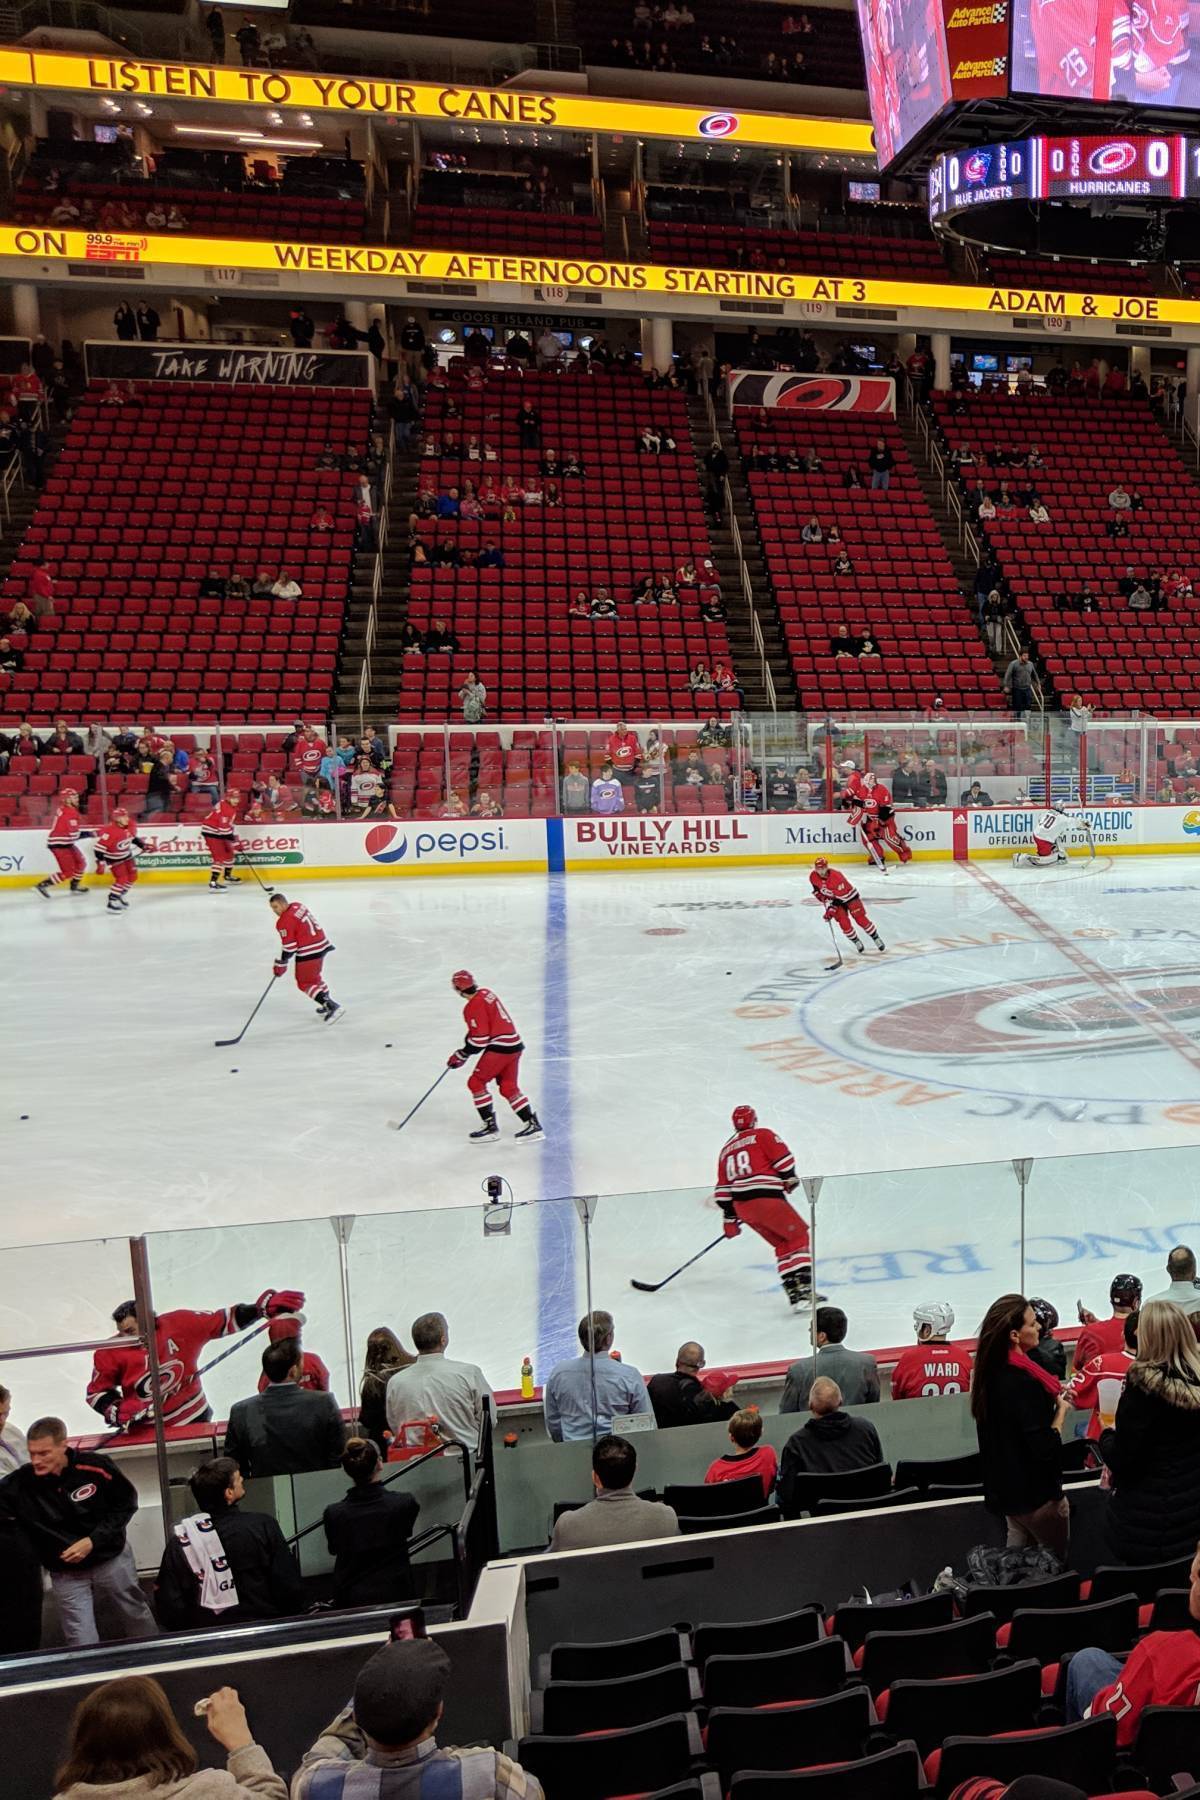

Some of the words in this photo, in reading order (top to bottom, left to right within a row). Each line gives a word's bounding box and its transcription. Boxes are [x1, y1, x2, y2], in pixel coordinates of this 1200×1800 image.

[947, 19, 968, 28] Auto
[968, 16, 991, 26] Parts
[952, 6, 992, 19] Advance
[952, 71, 971, 80] Auto
[971, 69, 992, 79] Parts
[957, 60, 992, 71] Advance
[88, 60, 217, 97] LISTEN
[239, 73, 292, 104] TO
[312, 79, 417, 113] YOUR
[438, 88, 557, 125] CANES
[1012, 152, 1021, 175] 0
[1053, 149, 1064, 173] 0
[1071, 140, 1080, 177] SOG
[1148, 141, 1169, 178] 0
[950, 157, 959, 190] 0
[955, 192, 972, 206] BLUE
[974, 186, 1013, 203] JACKETS
[1069, 181, 1151, 194] HURRICANES
[15, 230, 68, 256] ON
[86, 233, 113, 246] 99.9
[217, 269, 236, 281] 117
[274, 245, 428, 275] WEEKDAY
[446, 256, 648, 289] AFTERNOONS
[664, 269, 796, 298] STARTING
[812, 279, 844, 300] AT
[852, 281, 867, 302] 3
[545, 287, 565, 299] 118
[805, 303, 822, 314] 119
[988, 290, 1066, 314] ADAM
[1081, 296, 1098, 316] &
[1113, 298, 1159, 320] JOE
[452, 311, 501, 325] GOOSE
[505, 314, 555, 327] ISLAND
[559, 316, 585, 328] PUB
[1046, 316, 1063, 328] 120
[151, 350, 208, 378] TAKE
[219, 350, 325, 386] WARNING
[973, 809, 1034, 834] RALEIGH
[576, 820, 672, 844] BULLY
[682, 819, 749, 841] HILL
[785, 826, 857, 846] Michael
[904, 825, 936, 842] Son
[988, 833, 1035, 846] OFFICIAL
[141, 834, 210, 853] Harri
[238, 836, 300, 851] eeter
[415, 827, 506, 859] pepsi
[607, 840, 722, 856] VINEYARDS
[237, 854, 286, 865] Pharmacy
[746, 1035, 963, 1107] ARENA
[966, 1094, 1151, 1126] PNC
[167, 1338, 180, 1355] A
[924, 1362, 960, 1378] WARD
